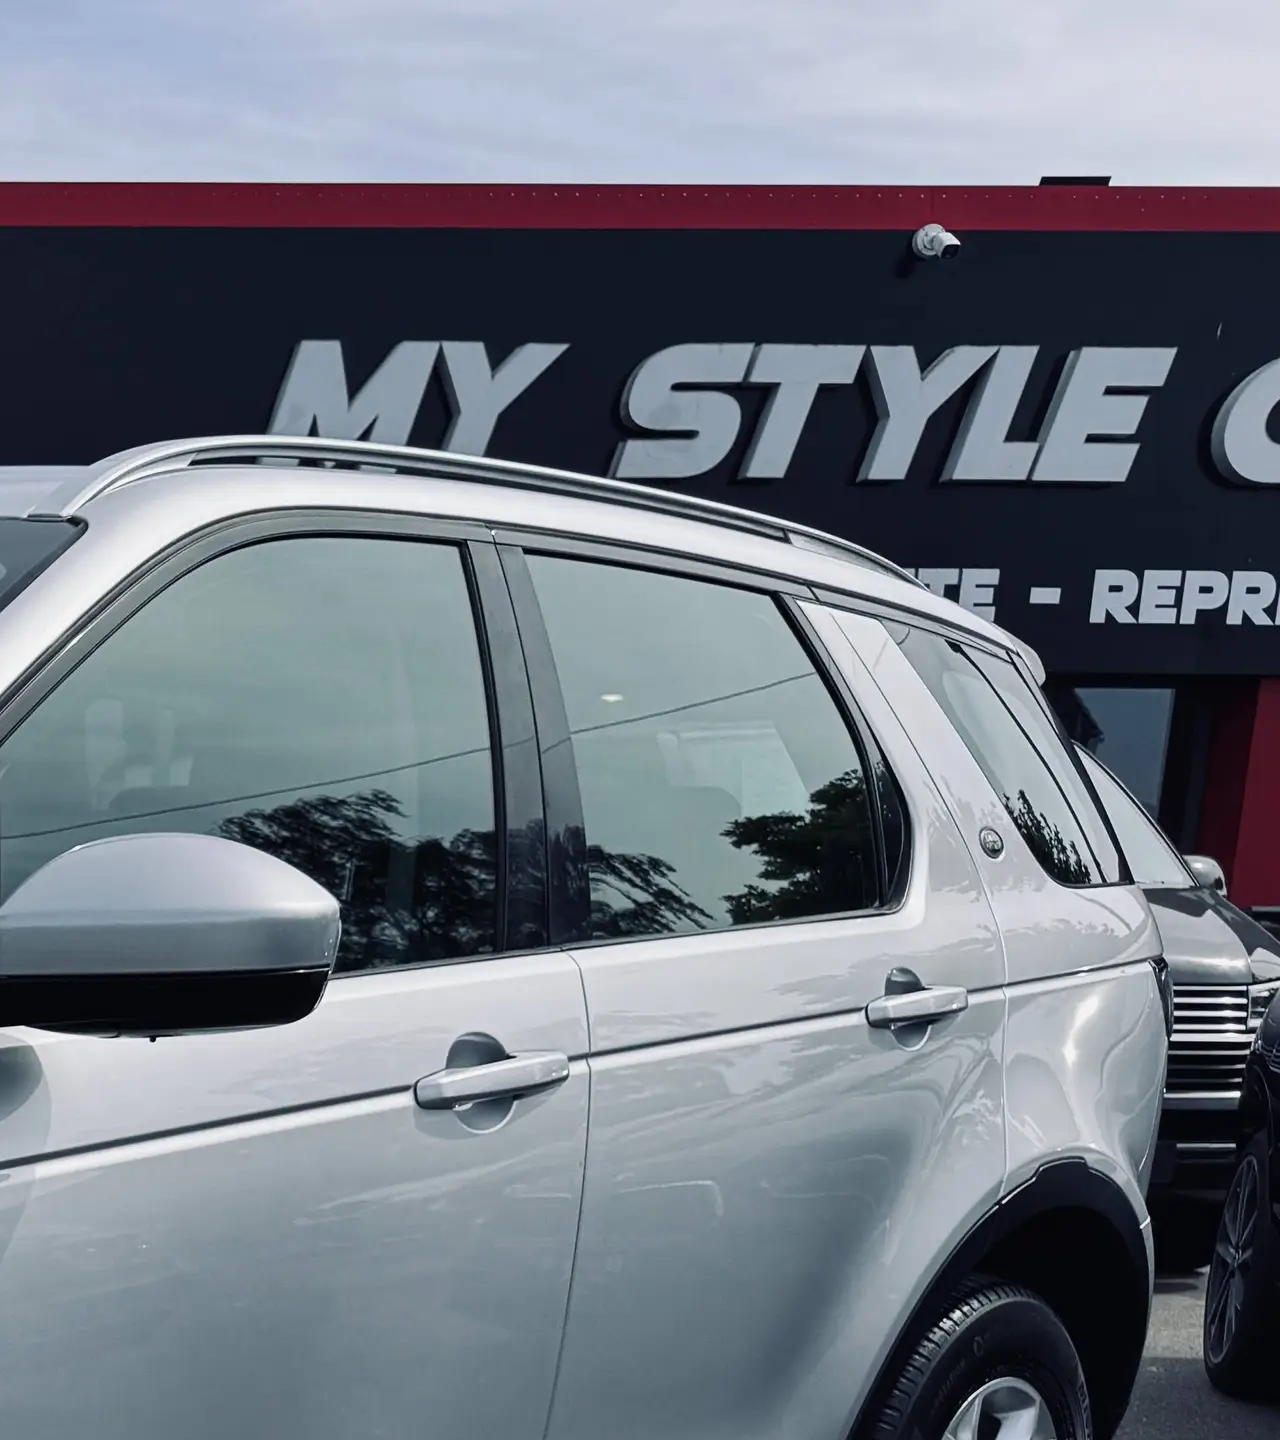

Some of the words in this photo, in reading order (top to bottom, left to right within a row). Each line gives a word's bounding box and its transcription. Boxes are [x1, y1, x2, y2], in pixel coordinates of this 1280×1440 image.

[258, 340, 572, 474] MY
[607, 342, 1178, 483] STYLE
[903, 567, 1000, 623] TE
[1089, 568, 1280, 626] REPR
